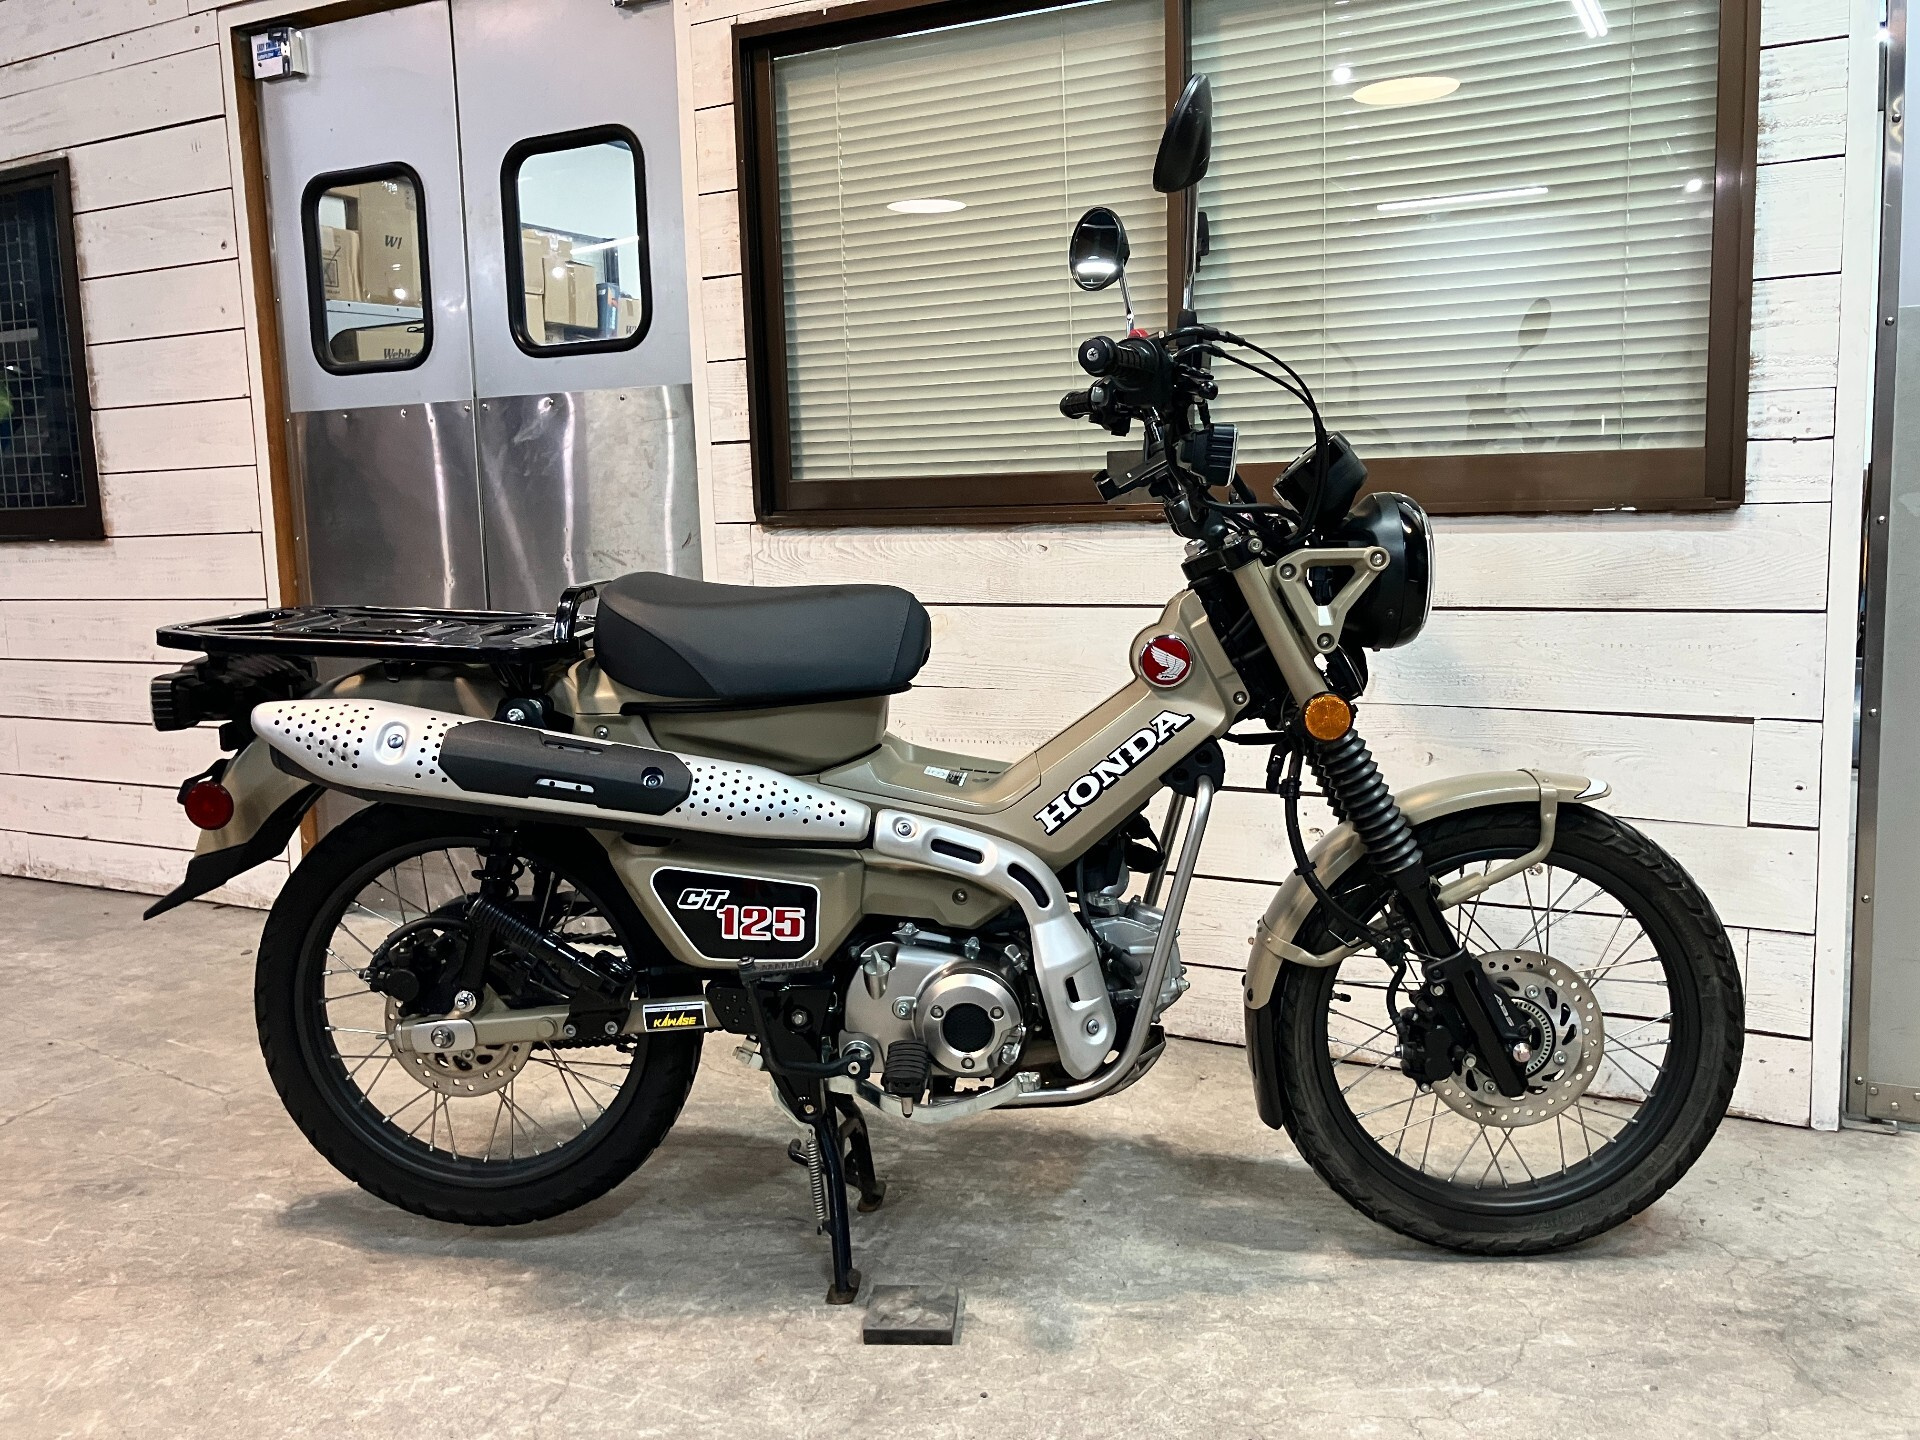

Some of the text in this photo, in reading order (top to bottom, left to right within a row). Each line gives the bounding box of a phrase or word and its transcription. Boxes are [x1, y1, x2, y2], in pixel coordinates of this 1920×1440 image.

[1033, 710, 1195, 836] HONDA
[677, 888, 805, 941] CT 125
[653, 1012, 697, 1028] KAWASE
